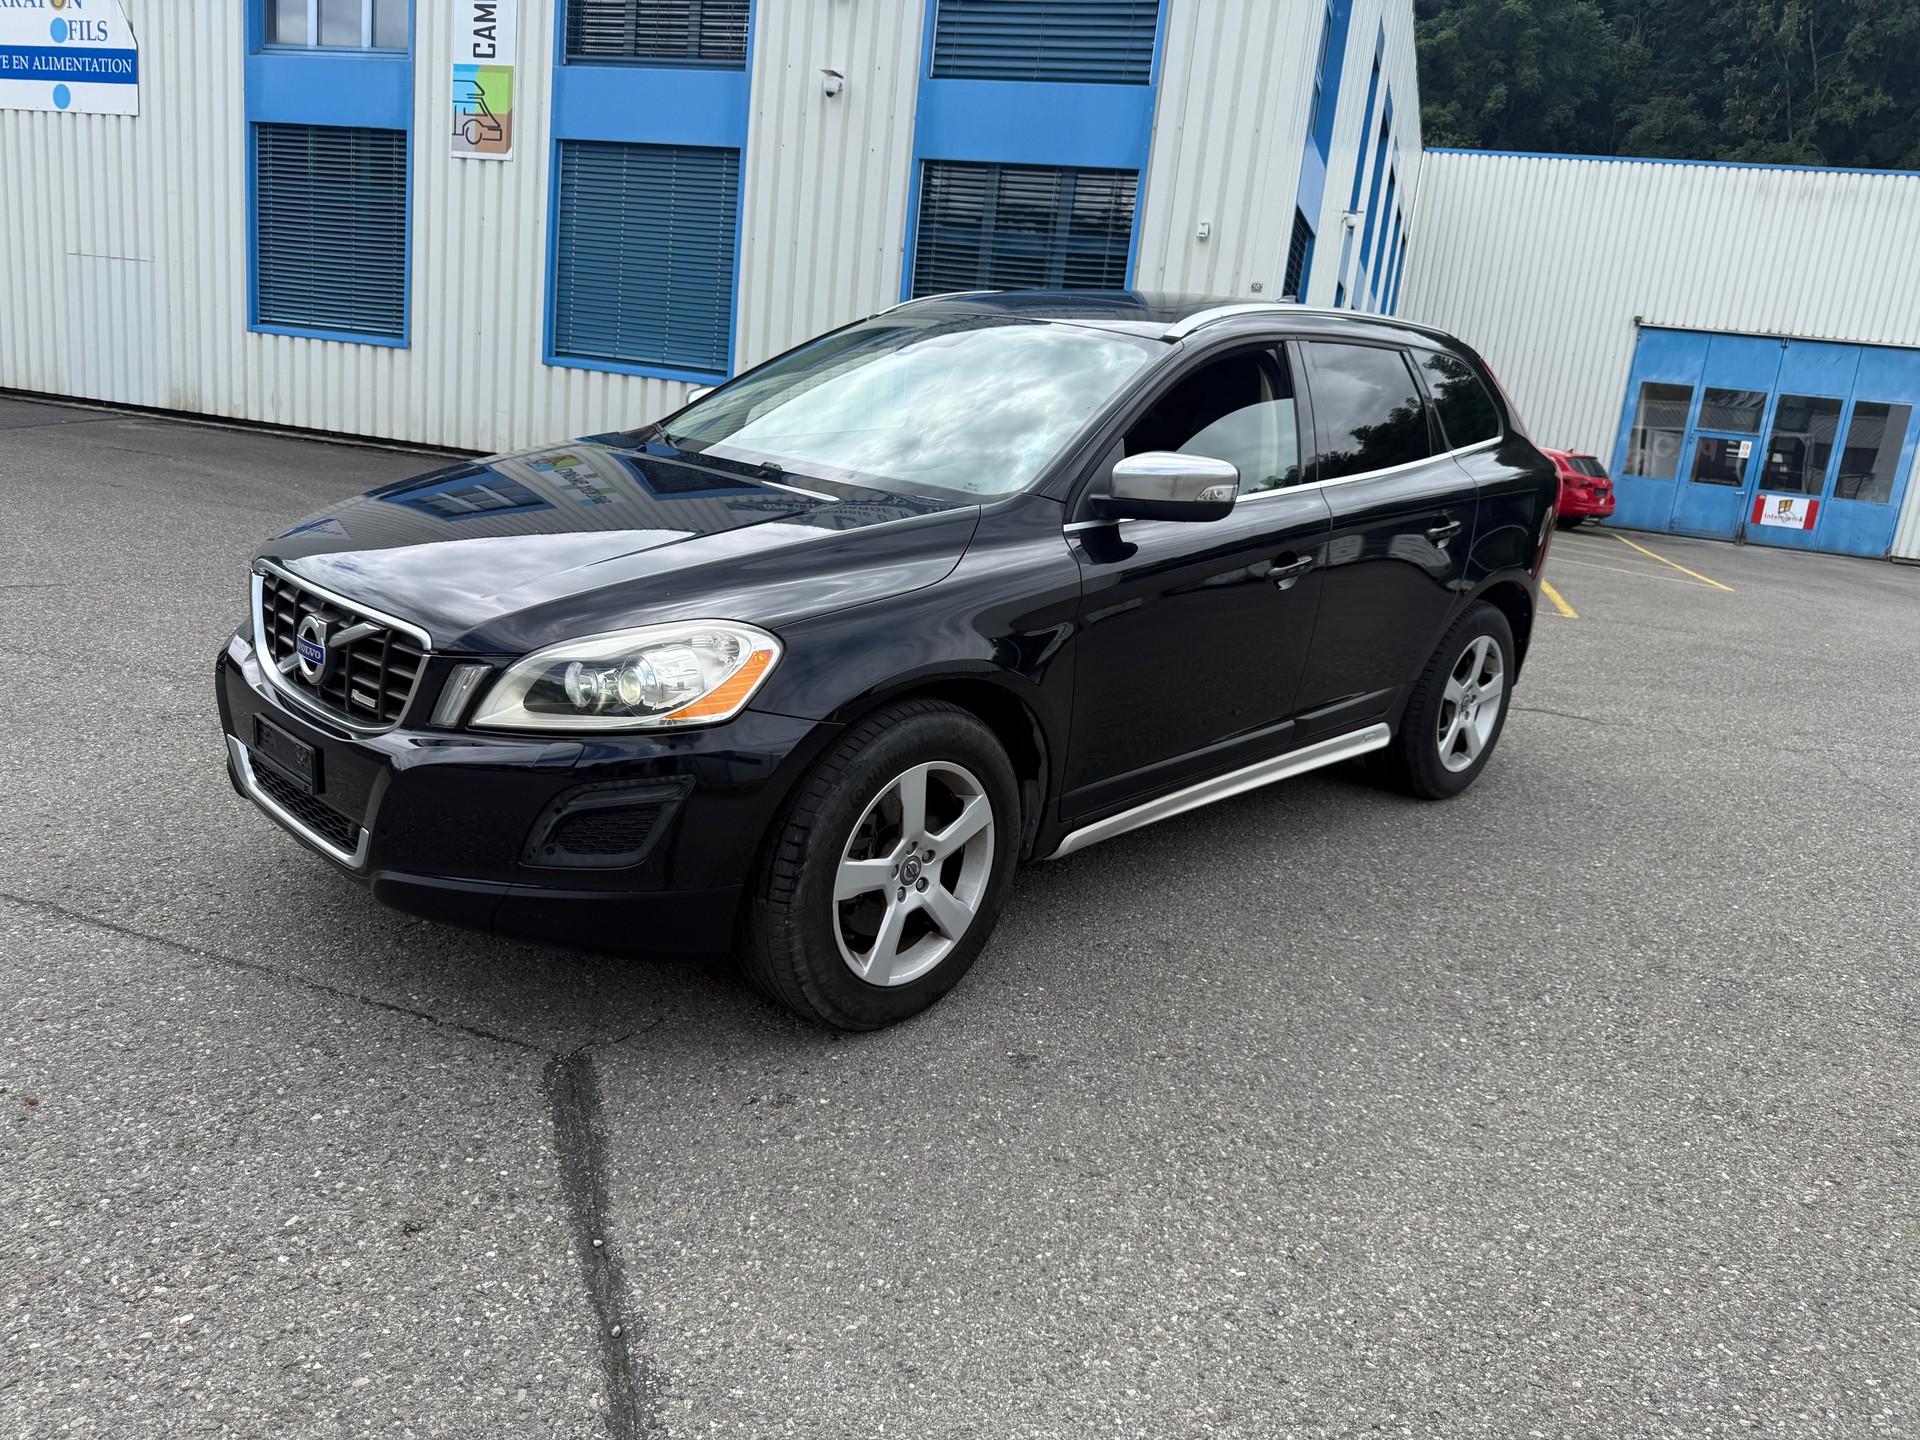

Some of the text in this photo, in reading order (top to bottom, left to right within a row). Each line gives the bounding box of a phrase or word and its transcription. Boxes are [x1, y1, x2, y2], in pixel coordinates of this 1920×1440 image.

[67, 20, 108, 42] FILS
[473, 0, 497, 58] CAM
[0, 54, 132, 74] E EN ALIMENTATION
[297, 639, 321, 660] VOLVO
